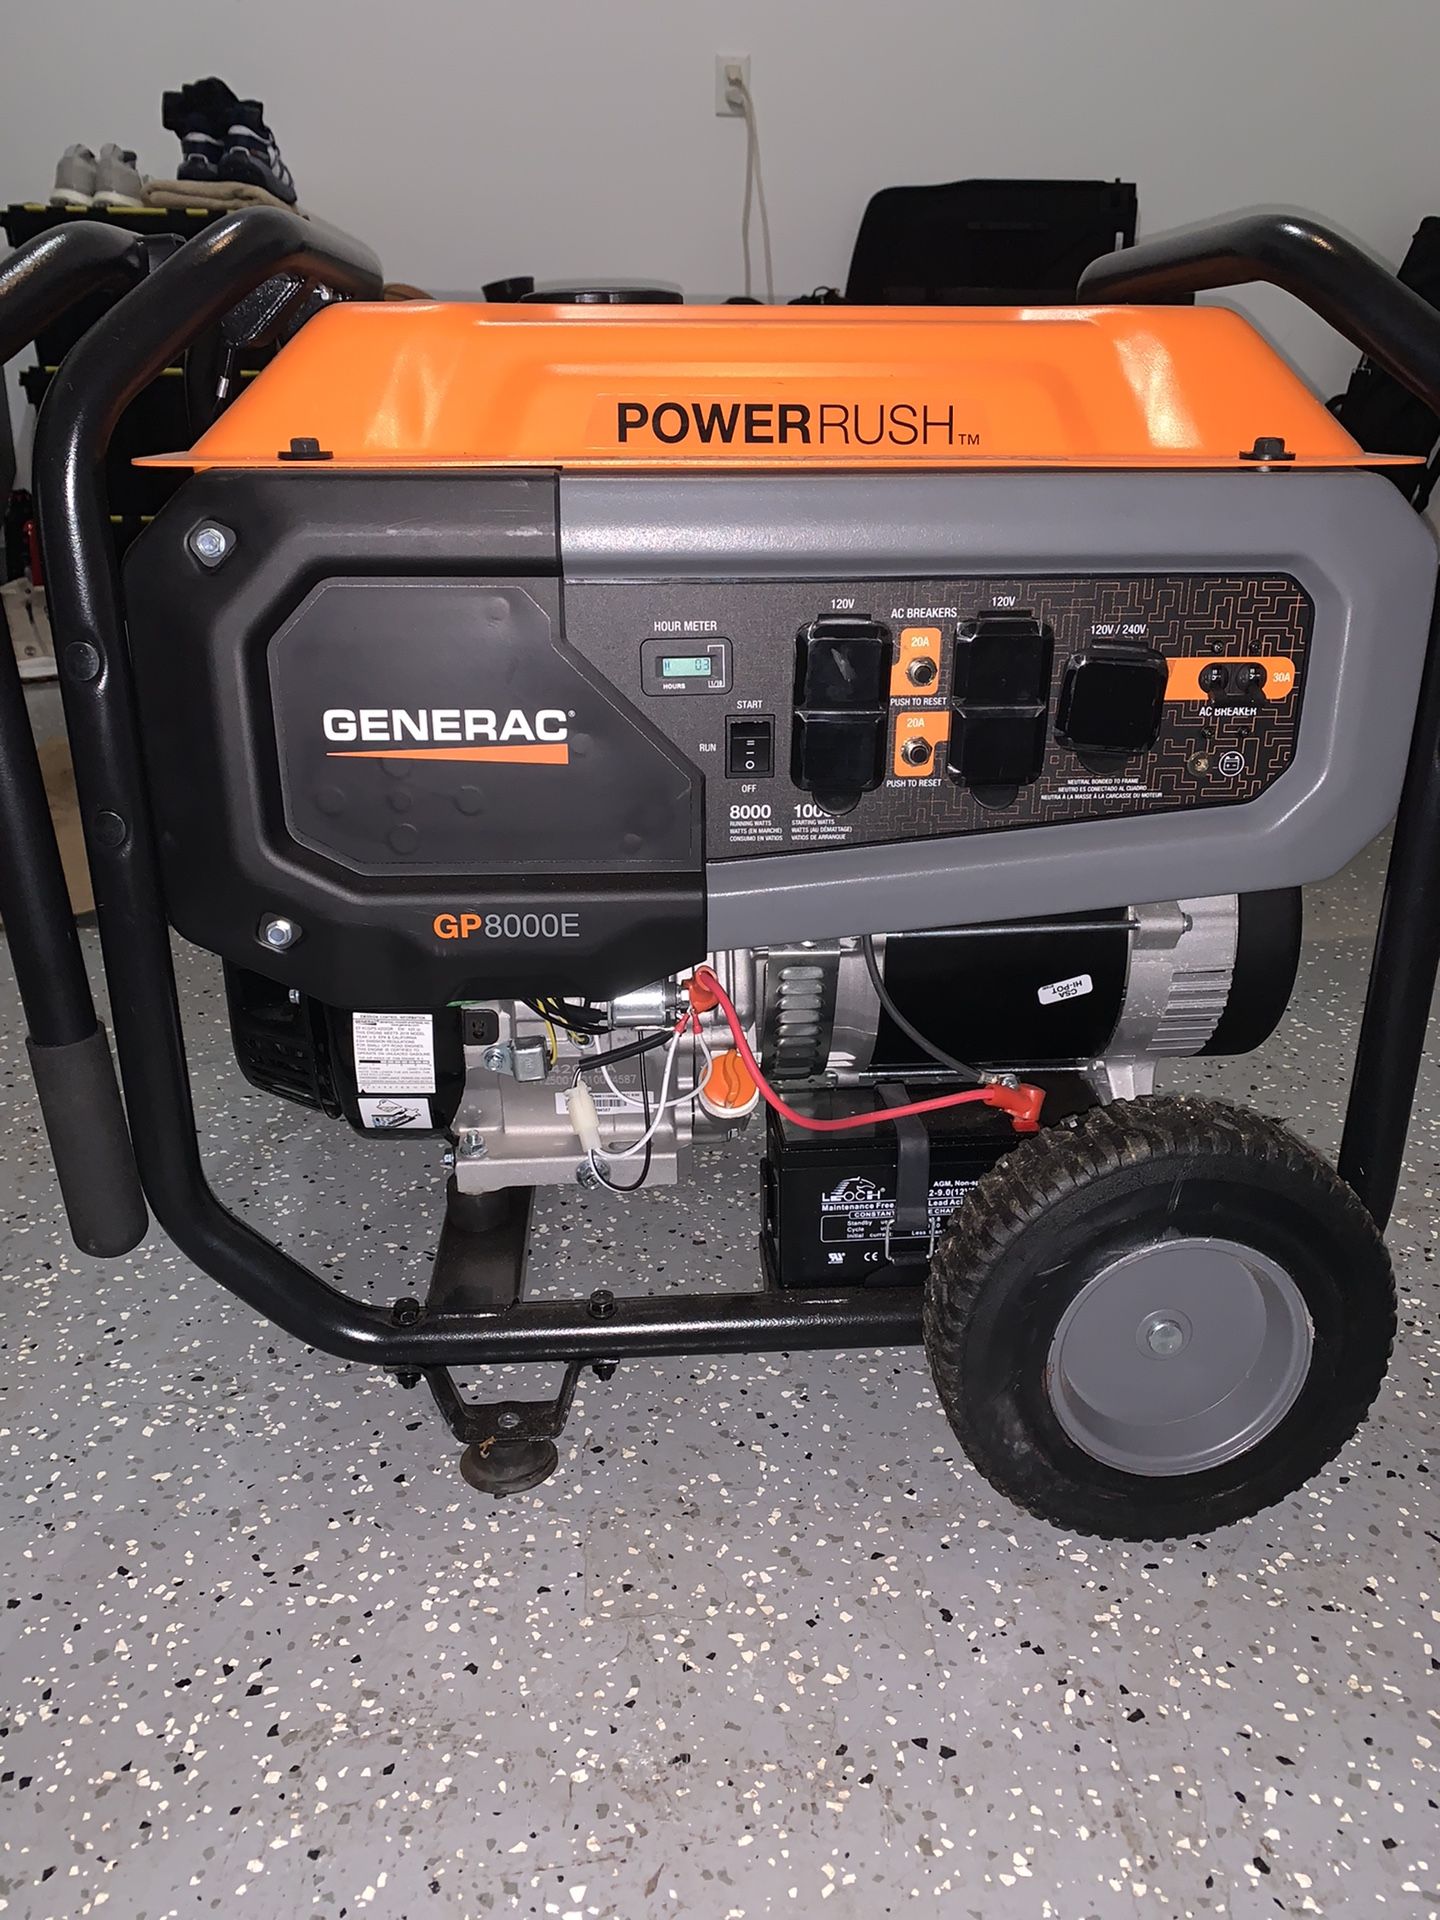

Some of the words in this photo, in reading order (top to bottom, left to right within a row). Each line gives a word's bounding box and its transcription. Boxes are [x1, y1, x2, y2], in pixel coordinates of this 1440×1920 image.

[617, 402, 954, 445] POWERRUSH
[831, 598, 855, 609] 120V
[992, 596, 1016, 607] 120V
[891, 609, 905, 619] AC
[907, 607, 958, 619] BREAKERS
[654, 621, 682, 632] HOUR
[684, 620, 717, 632] METER
[1091, 624, 1114, 635] 120V
[1122, 623, 1147, 635] 240V
[911, 636, 929, 648] 20A
[1273, 672, 1291, 683] 30A
[736, 700, 763, 709] START
[890, 698, 910, 707] PUSH
[912, 697, 922, 706] TO
[923, 697, 947, 706] RESET
[1199, 706, 1214, 717] AC
[907, 718, 925, 728] 20A
[699, 743, 717, 752] RUN
[741, 784, 757, 793] OFF
[886, 779, 906, 788] PUSH
[907, 779, 917, 787] TO
[918, 778, 942, 787] RESET
[729, 805, 772, 819] 8000
[433, 913, 580, 939] GP8000E
[1052, 980, 1082, 994] HI-POT
[1059, 988, 1077, 998] CSA
[821, 1204, 875, 1212] Maintenance
[846, 1219, 873, 1227] Standby
[846, 1226, 865, 1234] Cycle
